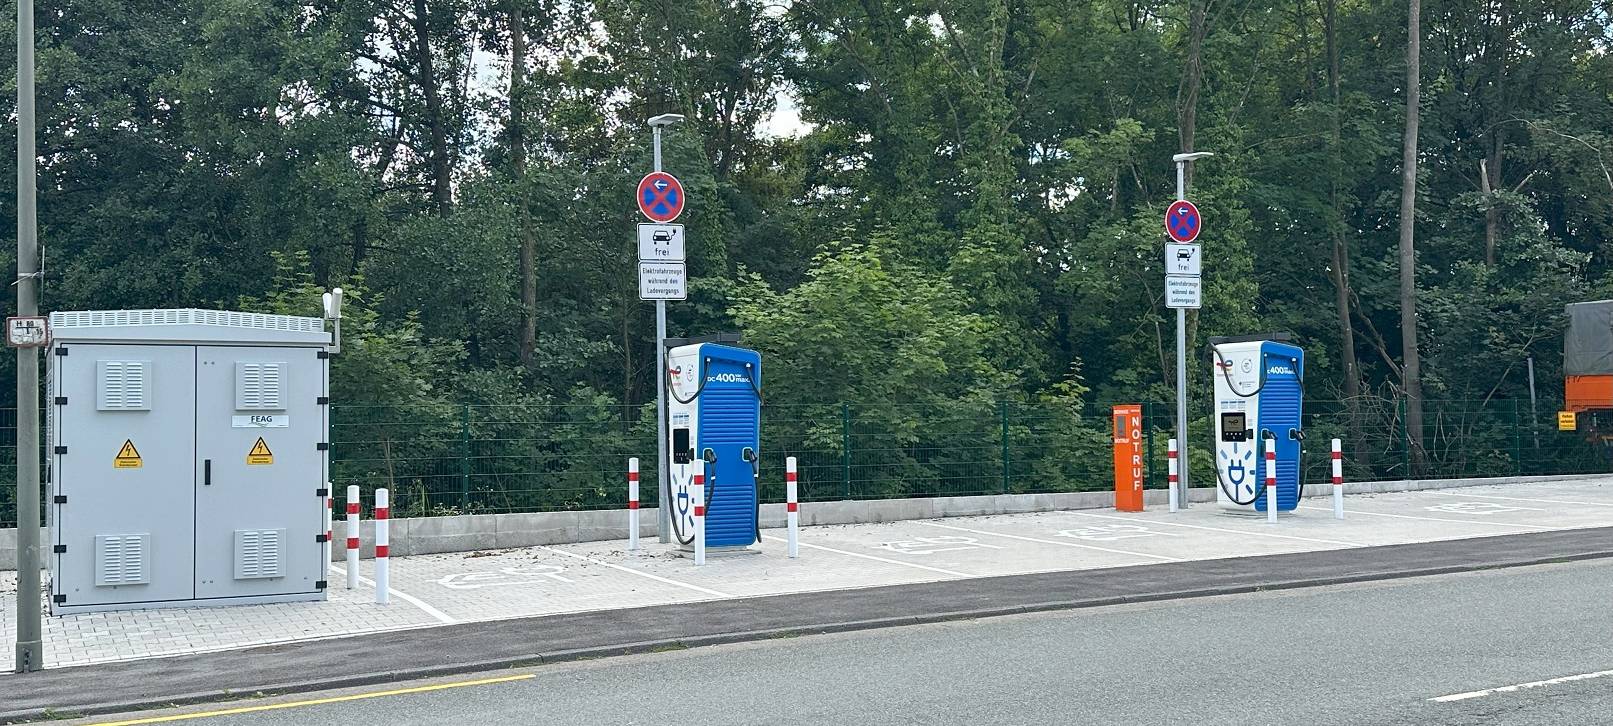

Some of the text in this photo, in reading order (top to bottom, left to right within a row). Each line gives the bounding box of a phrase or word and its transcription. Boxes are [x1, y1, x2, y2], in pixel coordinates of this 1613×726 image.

[655, 247, 670, 256] frei
[642, 267, 683, 276] Elektrofahrzeuge
[1178, 263, 1190, 271] frei
[1270, 366, 1283, 375] 400
[715, 373, 736, 383] 400
[250, 415, 273, 423] FEAG
[1131, 416, 1141, 491] NOTRUF
